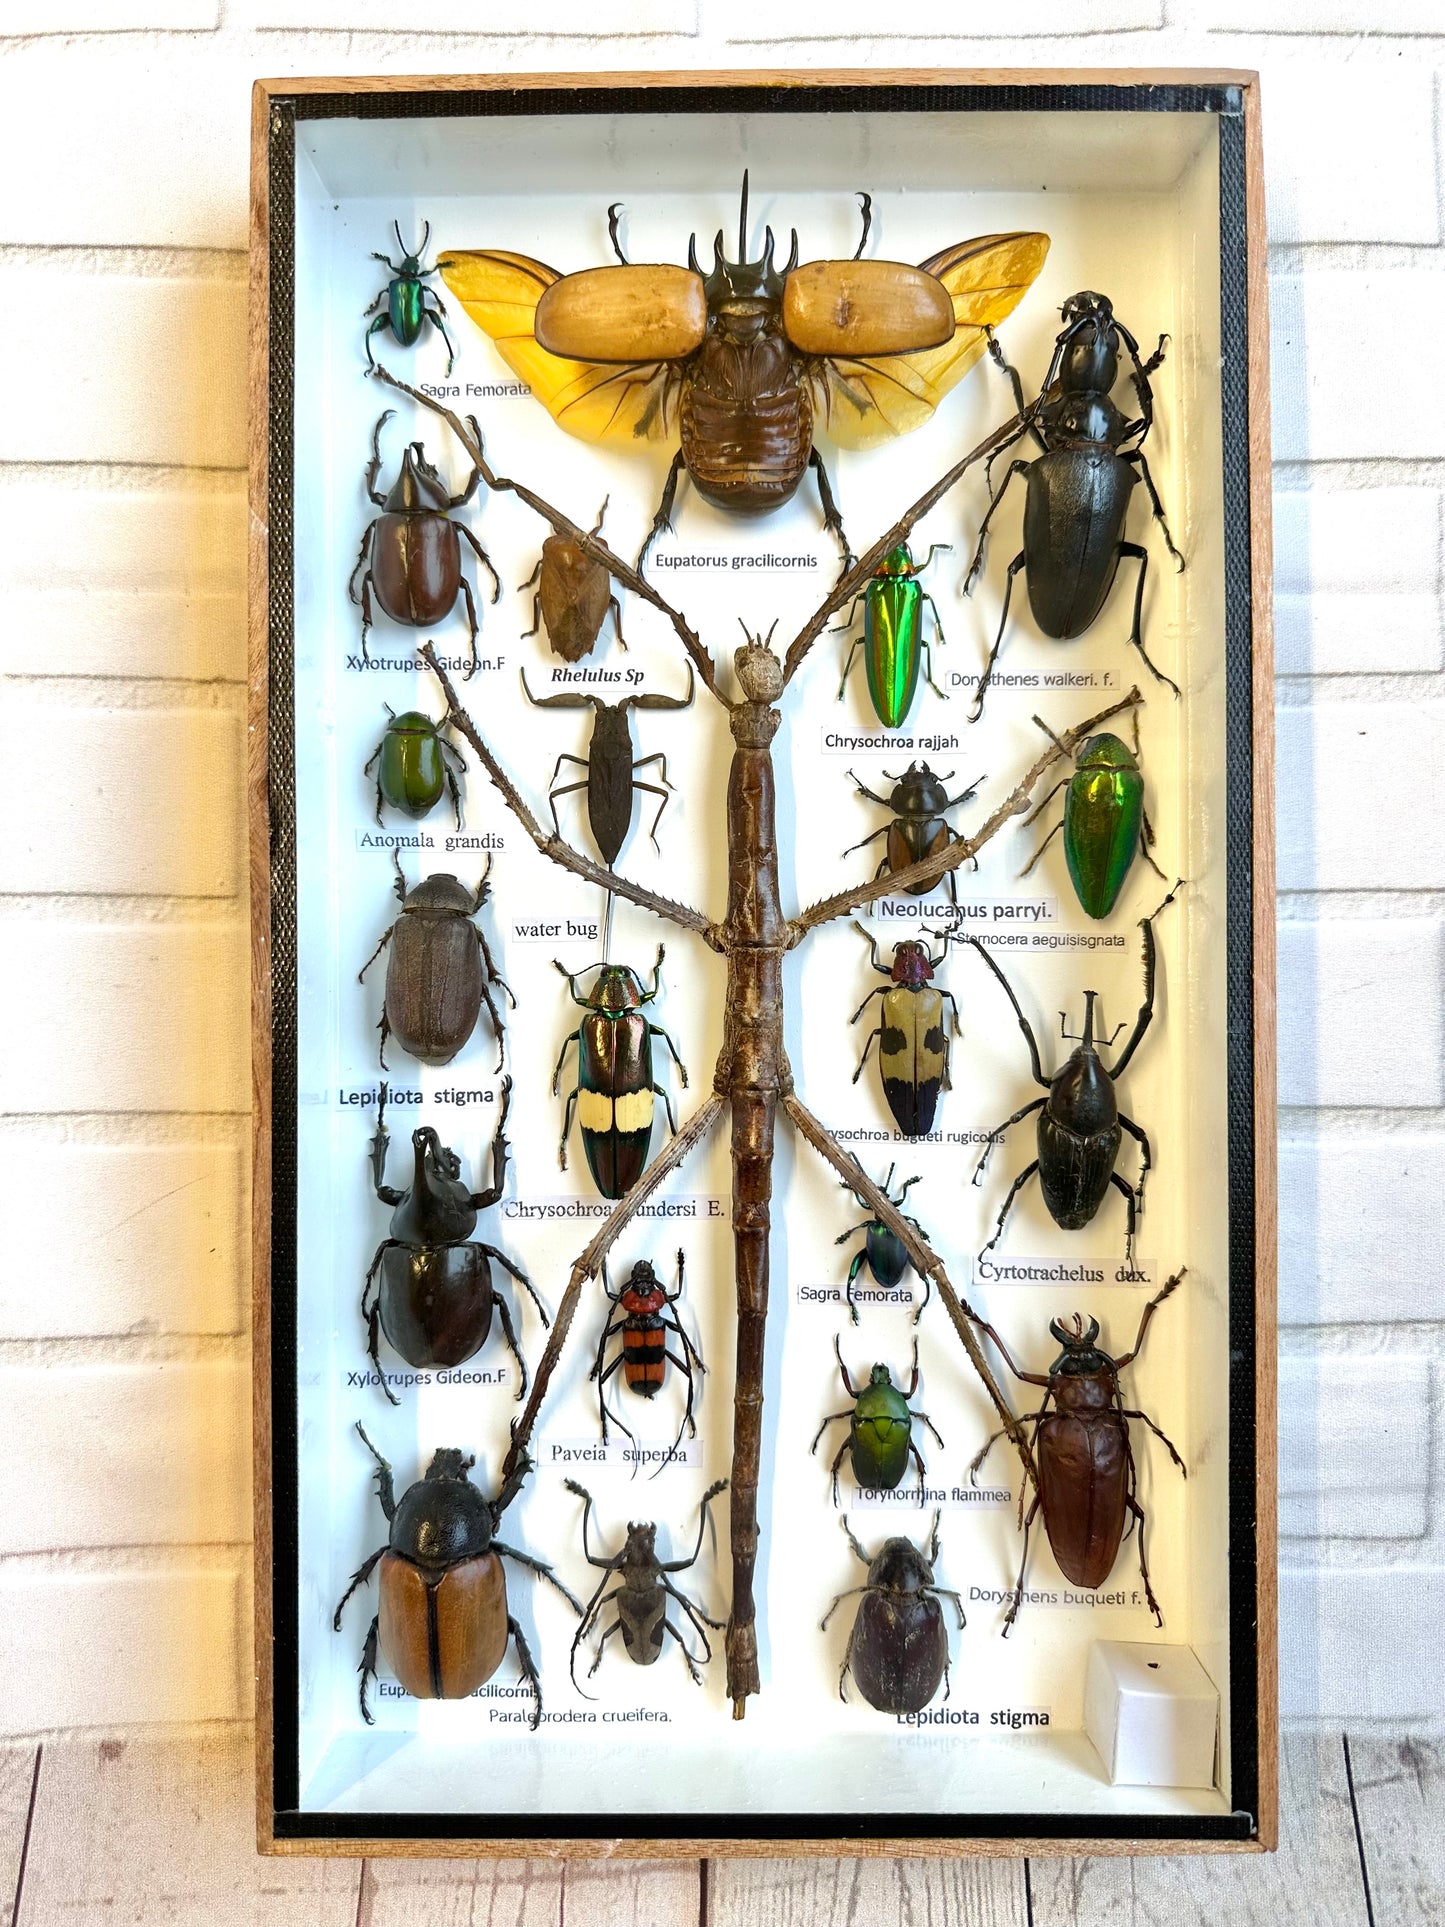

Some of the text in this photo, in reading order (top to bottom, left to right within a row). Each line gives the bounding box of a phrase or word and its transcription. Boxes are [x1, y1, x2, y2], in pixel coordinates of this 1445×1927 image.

[420, 383, 532, 399] Sagra Femorata
[655, 553, 818, 570] Eupatorus gracilicornis
[345, 655, 506, 672] Xylotrupes Gideon.F
[551, 668, 645, 686] Rhelulus Sp
[1043, 671, 1098, 687] walkeri.
[1103, 671, 1114, 687] f.
[825, 734, 960, 752] Chrysochroa rajjah
[360, 832, 505, 852] Anomala grandis
[881, 900, 1052, 922] Neolucanus parryi.
[514, 920, 599, 940] water bug
[433, 1088, 495, 1107] stigma
[826, 1128, 890, 1142] ysochroa
[505, 1200, 725, 1219] Chrysochroa undersi E.
[979, 1262, 1151, 1283] Cyrtotrachelus dux.
[800, 1286, 841, 1304] Sagra
[435, 1369, 507, 1386] Gideon.F
[551, 1444, 688, 1466] Paveia superba
[855, 1485, 1012, 1503] Torynorrhina flammea
[969, 1586, 1142, 1608] Doryshens buqueti f.
[602, 1708, 672, 1723] crueifera.
[896, 1707, 1050, 1730] Lepidiota stigma
